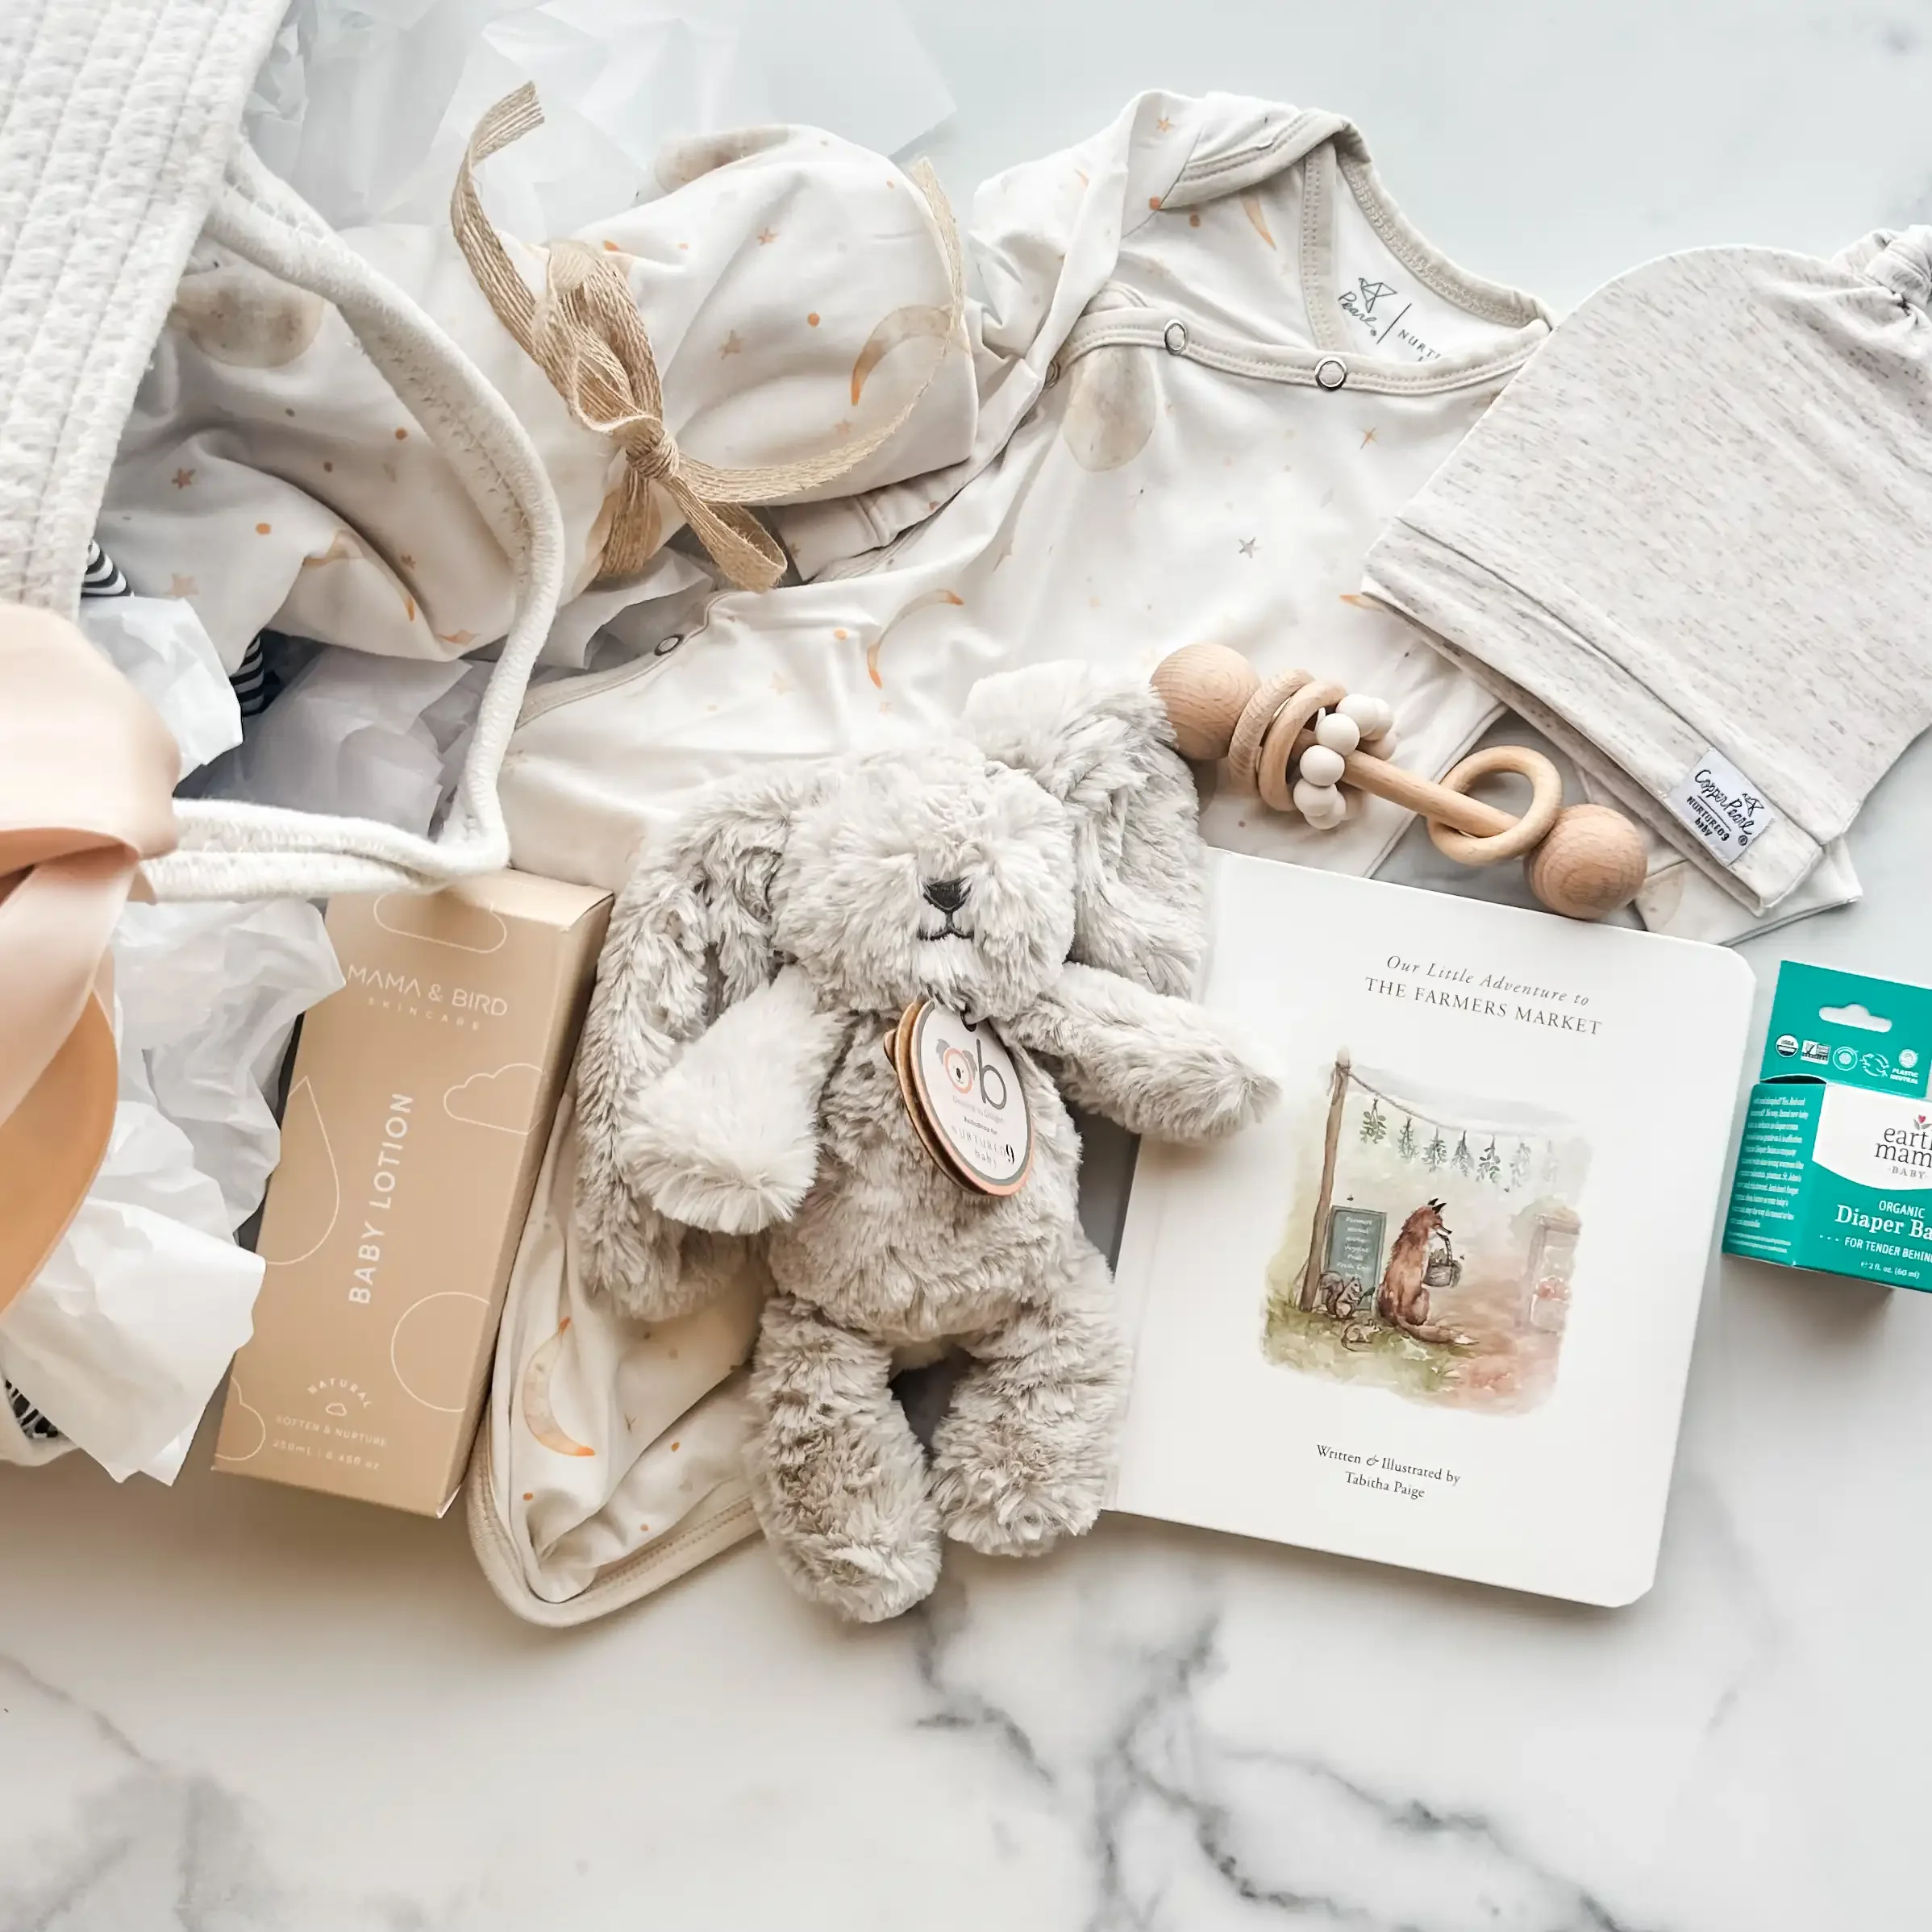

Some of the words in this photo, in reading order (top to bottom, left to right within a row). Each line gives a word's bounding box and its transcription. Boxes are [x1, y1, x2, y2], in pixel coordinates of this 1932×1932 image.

[1694, 817, 1713, 837] baby
[347, 964, 422, 998] MAMA
[428, 983, 443, 1002] &
[452, 988, 509, 1017] BIRD
[1387, 955, 1420, 974] Our
[1426, 963, 1474, 985] Little
[1478, 973, 1567, 1002] Adventure
[1574, 993, 1589, 1007] to
[368, 996, 480, 1031] SKINCARE
[1365, 976, 1407, 998] THE
[1414, 986, 1508, 1018] FARMERS
[1514, 1006, 1602, 1035] MARKET
[1892, 1068, 1918, 1078] PLASTIC
[1884, 1128, 1932, 1151] eart
[1892, 1166, 1926, 1179] BABY
[348, 1220, 385, 1304] BABY
[368, 1093, 413, 1210] LOTION
[1879, 1200, 1926, 1219] ORGANIC
[1834, 1204, 1905, 1234] Diaper
[1844, 1236, 1863, 1249] FOR
[1865, 1240, 1901, 1256] TENDER
[306, 1377, 373, 1409] NATURAL
[335, 1427, 387, 1447] NURTURE
[1317, 1444, 1361, 1464] Written
[1366, 1455, 1380, 1467] &
[1381, 1457, 1442, 1481] Illustrated
[1446, 1468, 1461, 1487] by
[1345, 1470, 1389, 1492] Tabitha
[1393, 1480, 1426, 1500] Paige
